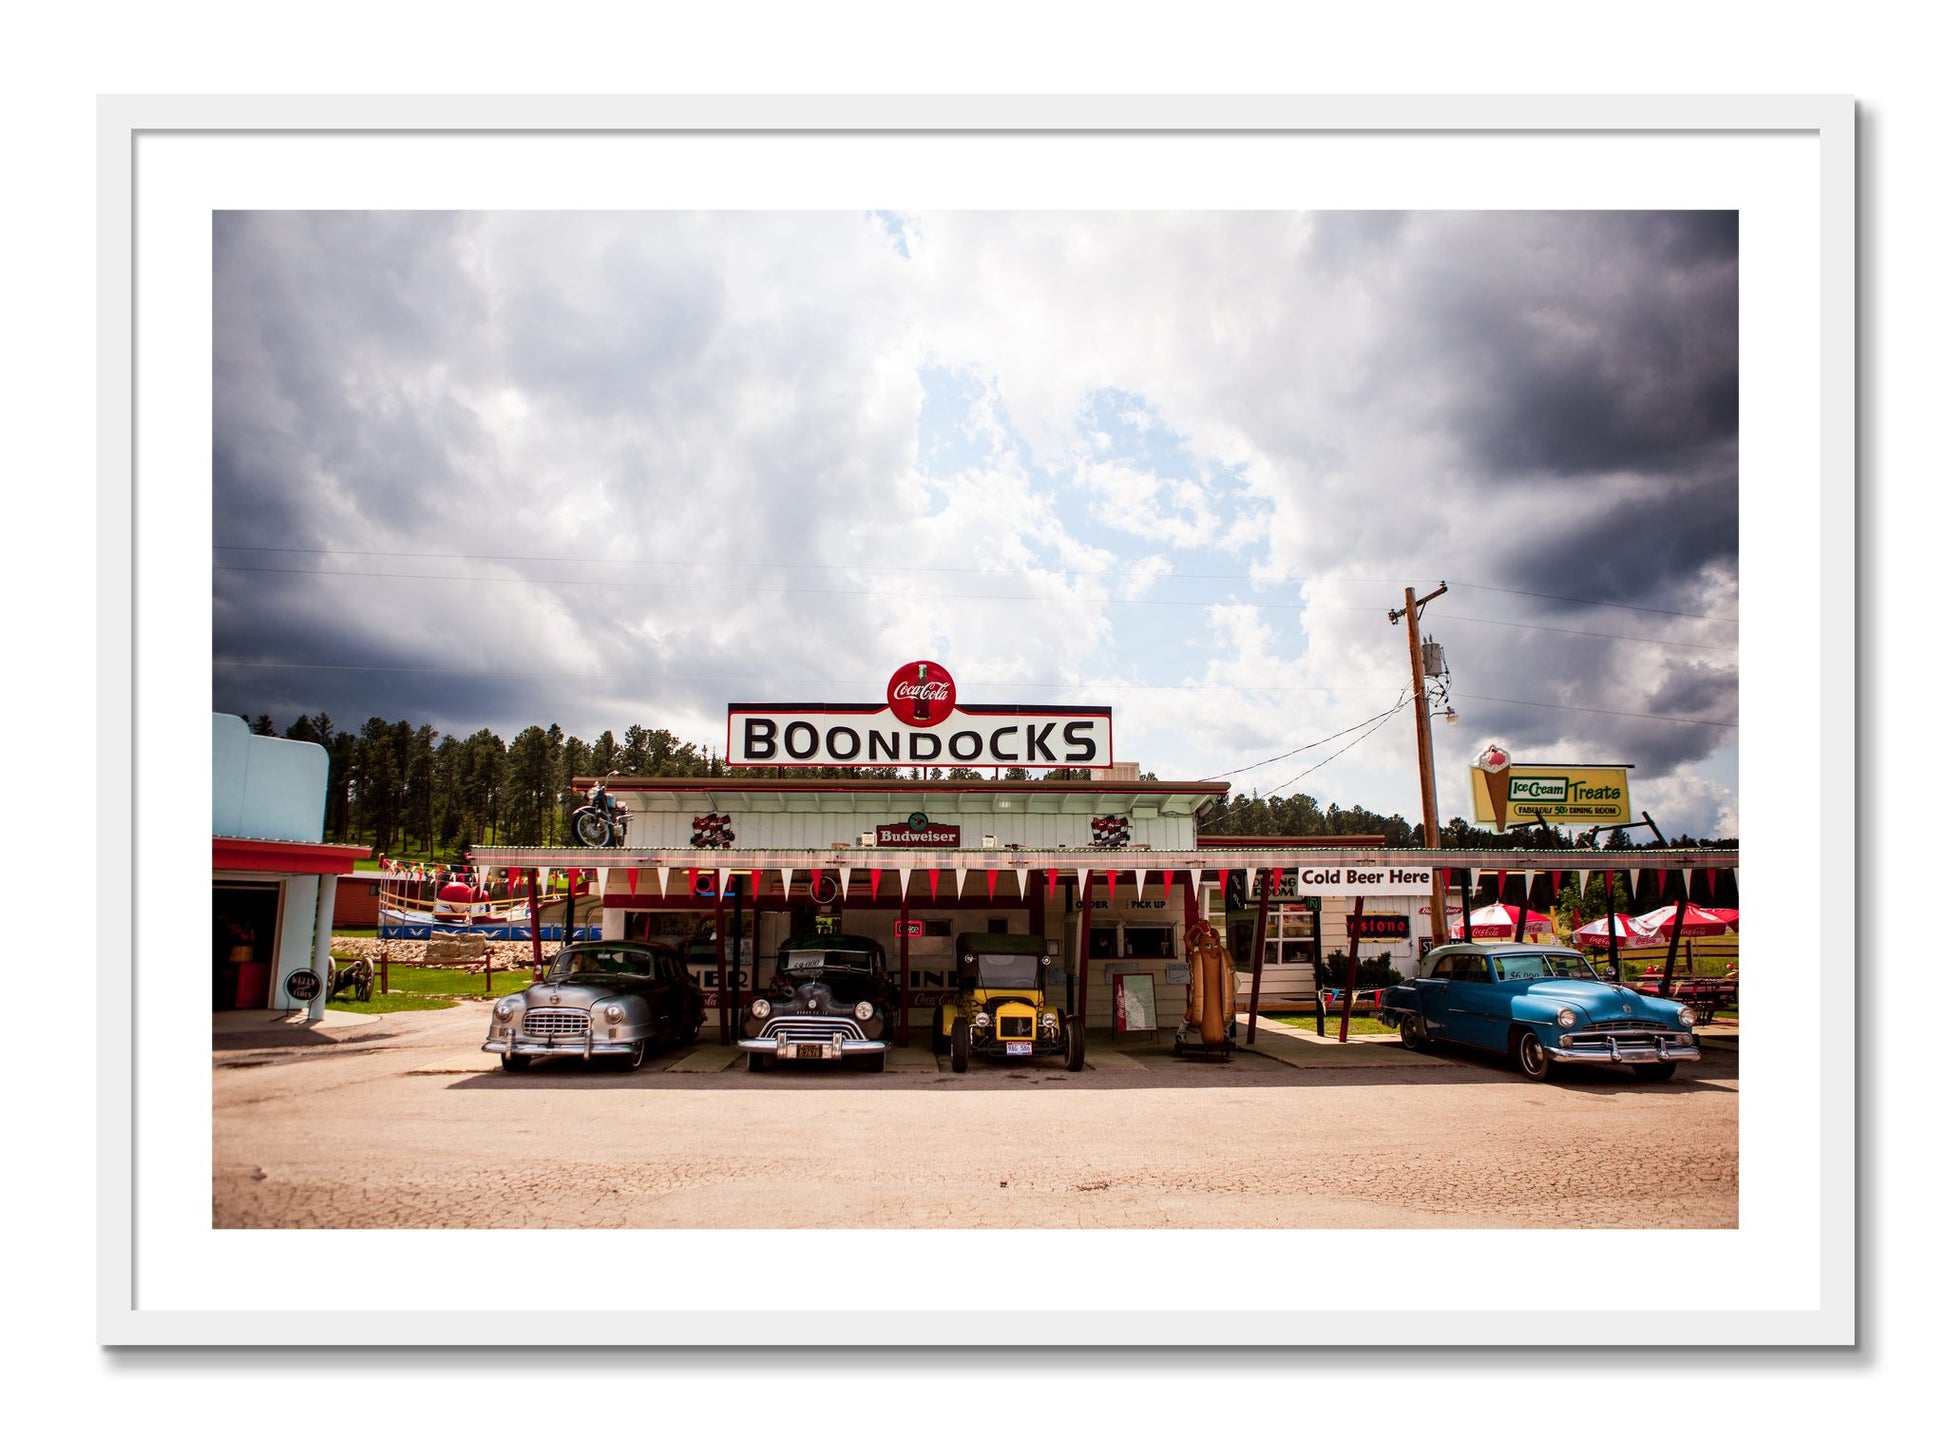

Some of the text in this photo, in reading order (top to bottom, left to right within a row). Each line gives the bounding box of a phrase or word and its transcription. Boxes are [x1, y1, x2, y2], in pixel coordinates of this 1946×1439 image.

[893, 680, 951, 701] Coca-Cola
[743, 718, 1097, 762] BOONDOCKS
[1513, 781, 1621, 802] Ice Cream Treats
[1569, 806, 1593, 815] DINING
[1595, 806, 1617, 815] ROOM
[880, 830, 956, 842] Budweiser
[1301, 869, 1430, 885] Cold Beer Here
[1076, 900, 1109, 909] ODER
[1131, 900, 1166, 909] PICK UP
[1589, 936, 1611, 946] Coca-Co
